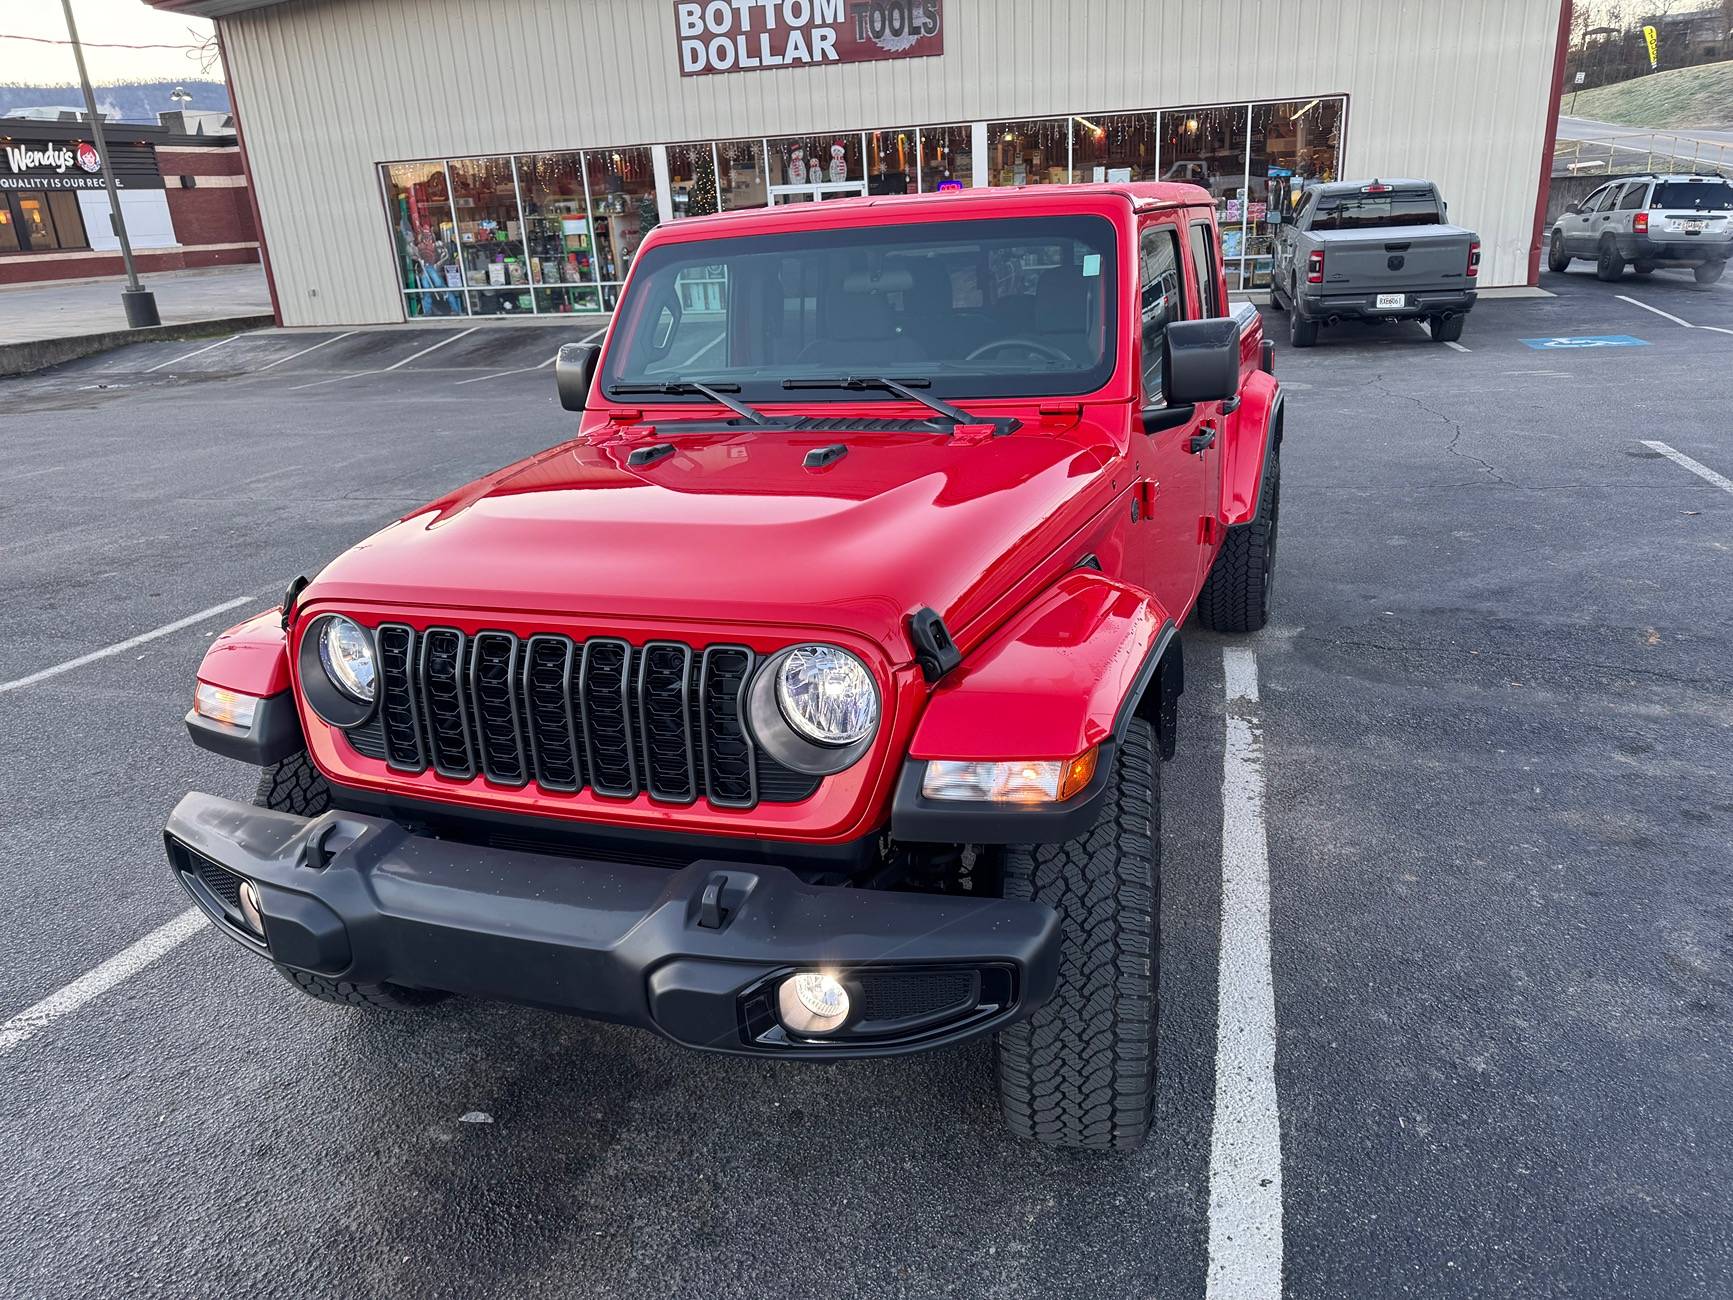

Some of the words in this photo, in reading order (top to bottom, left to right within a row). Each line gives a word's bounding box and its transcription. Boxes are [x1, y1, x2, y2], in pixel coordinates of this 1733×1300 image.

[678, 0, 845, 37] BOTTOM
[850, 0, 939, 42] TOOLS
[682, 27, 840, 73] DOLLAR
[6, 142, 74, 173] Wendy's
[0, 178, 48, 188] QUALITY
[51, 179, 60, 187] IS
[63, 179, 85, 187] OUR
[87, 178, 124, 188] RECE.
